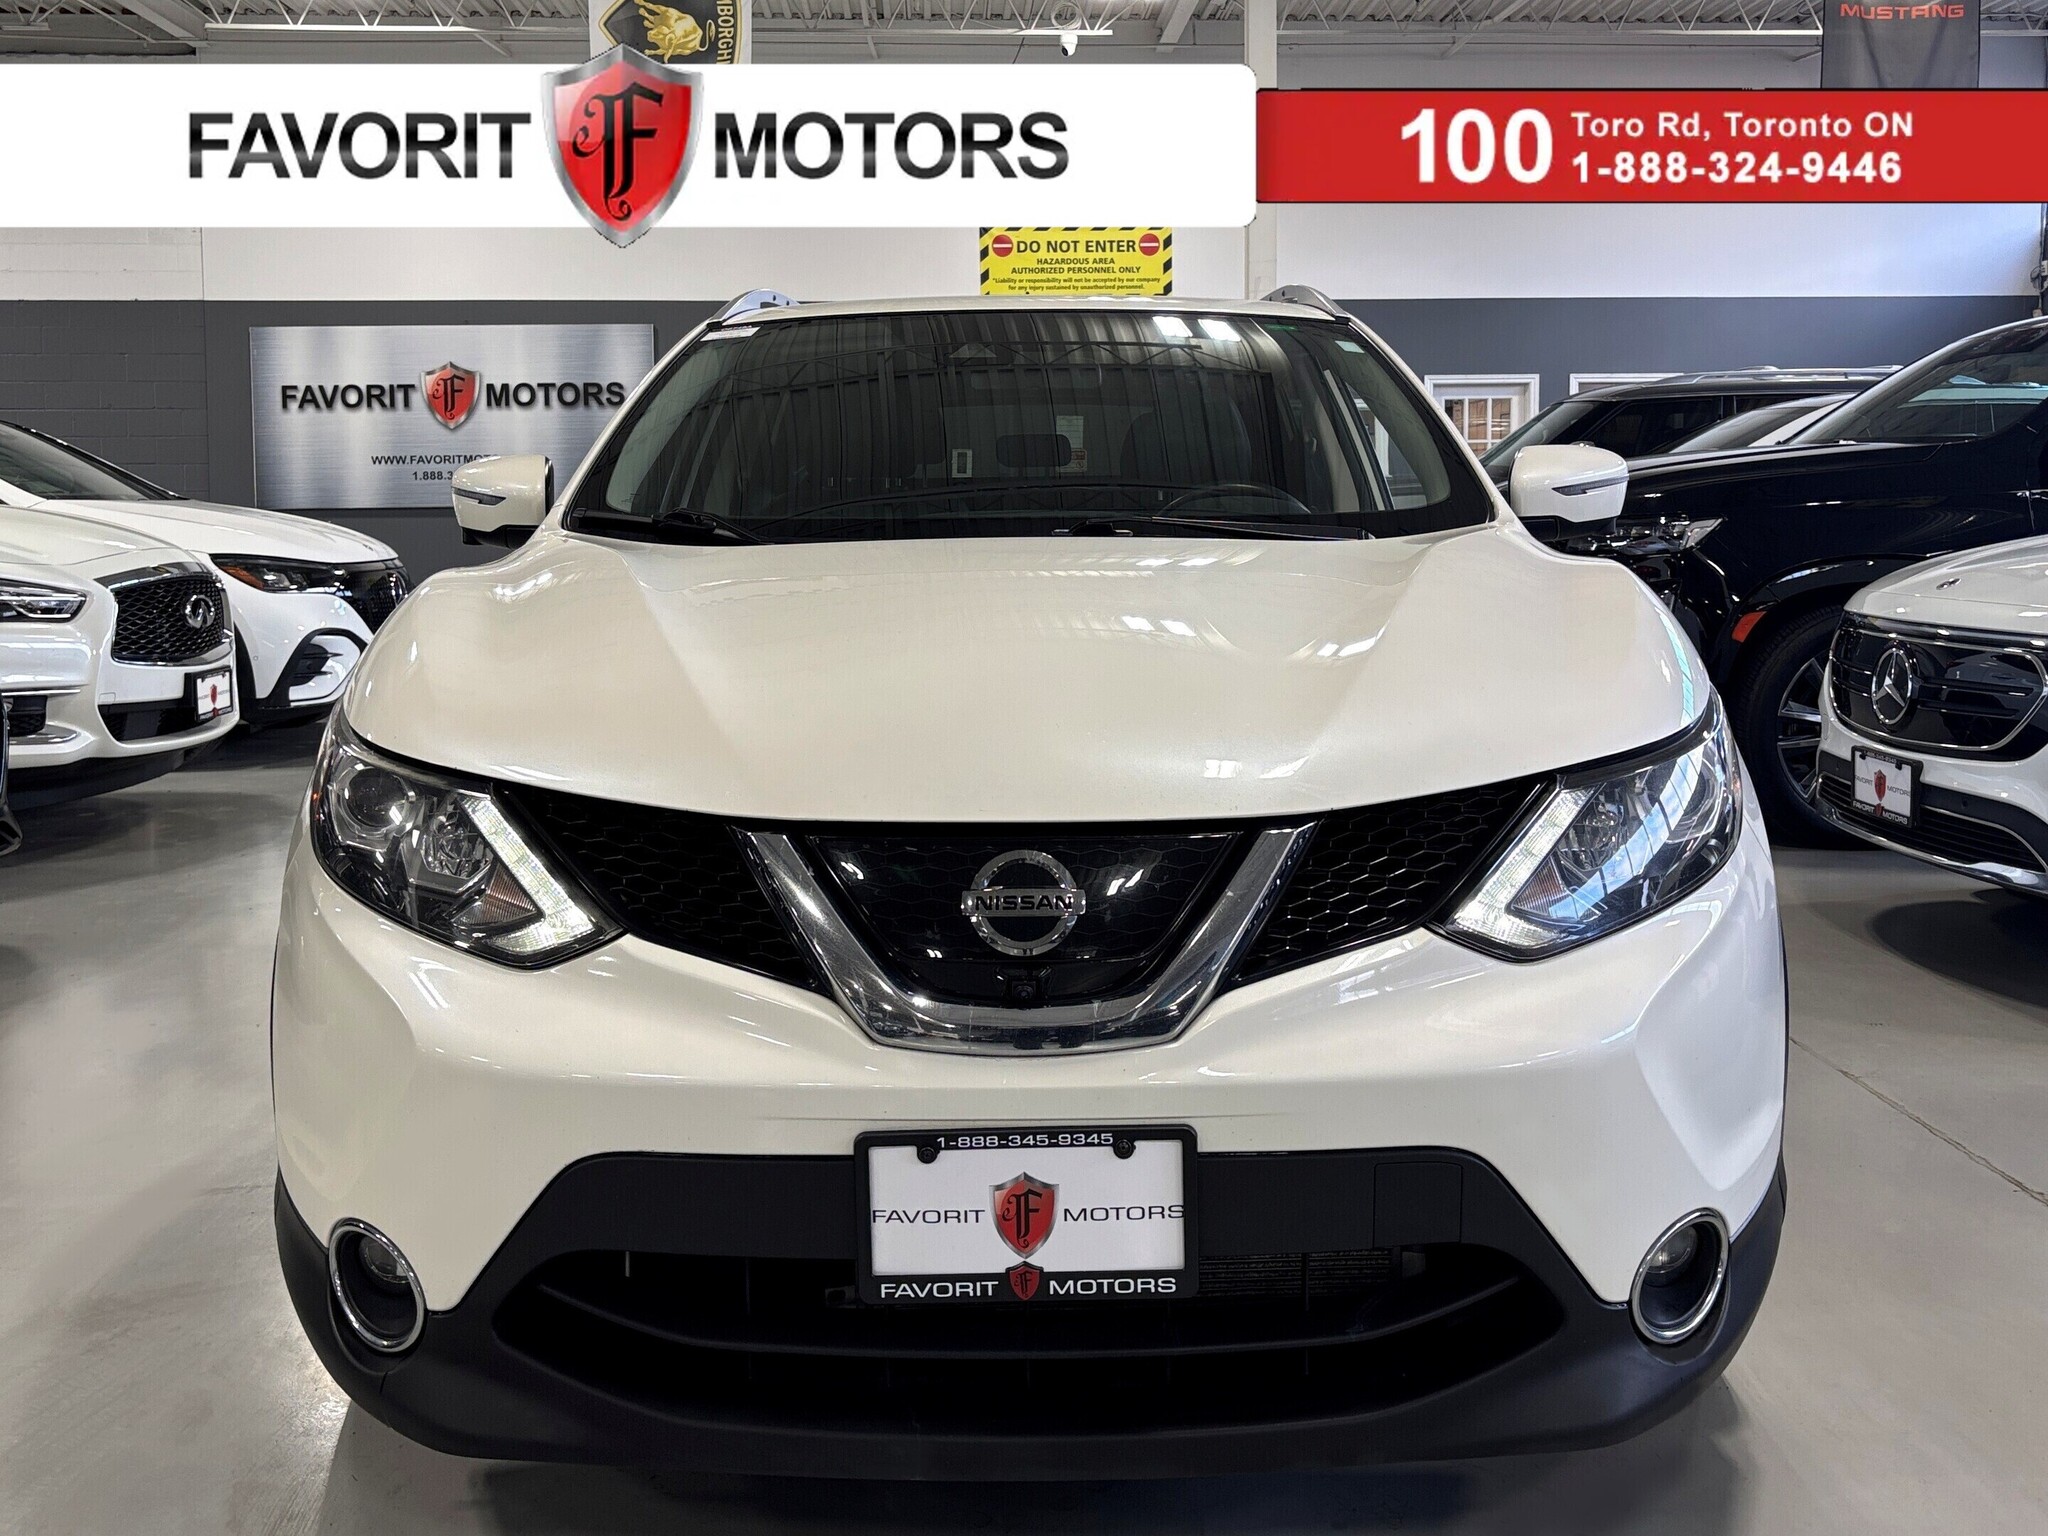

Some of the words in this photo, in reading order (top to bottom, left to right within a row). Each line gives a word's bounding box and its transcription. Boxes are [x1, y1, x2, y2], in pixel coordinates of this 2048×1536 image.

[1840, 4, 1965, 20] MUSTANG
[1017, 240, 1041, 254] DO
[1047, 240, 1080, 253] NOT
[1085, 239, 1137, 253] ENTER
[1037, 258, 1090, 266] HAZARDOUS
[1092, 257, 1115, 265] AREA
[1011, 267, 1064, 275] AUTHORIZED
[1067, 266, 1116, 274] PERSONNEL
[1119, 266, 1141, 274] ONLY
[281, 384, 416, 409] FAVORIT
[486, 382, 625, 407] MOTORS
[975, 895, 1073, 911] NISSAN
[936, 1133, 1114, 1149] 1-888-345-9345
[872, 1209, 985, 1224] FAVORIT
[1064, 1204, 1185, 1222] MOTORS
[880, 1281, 999, 1298] FAVORIT
[1049, 1277, 1177, 1295] MOTORS
